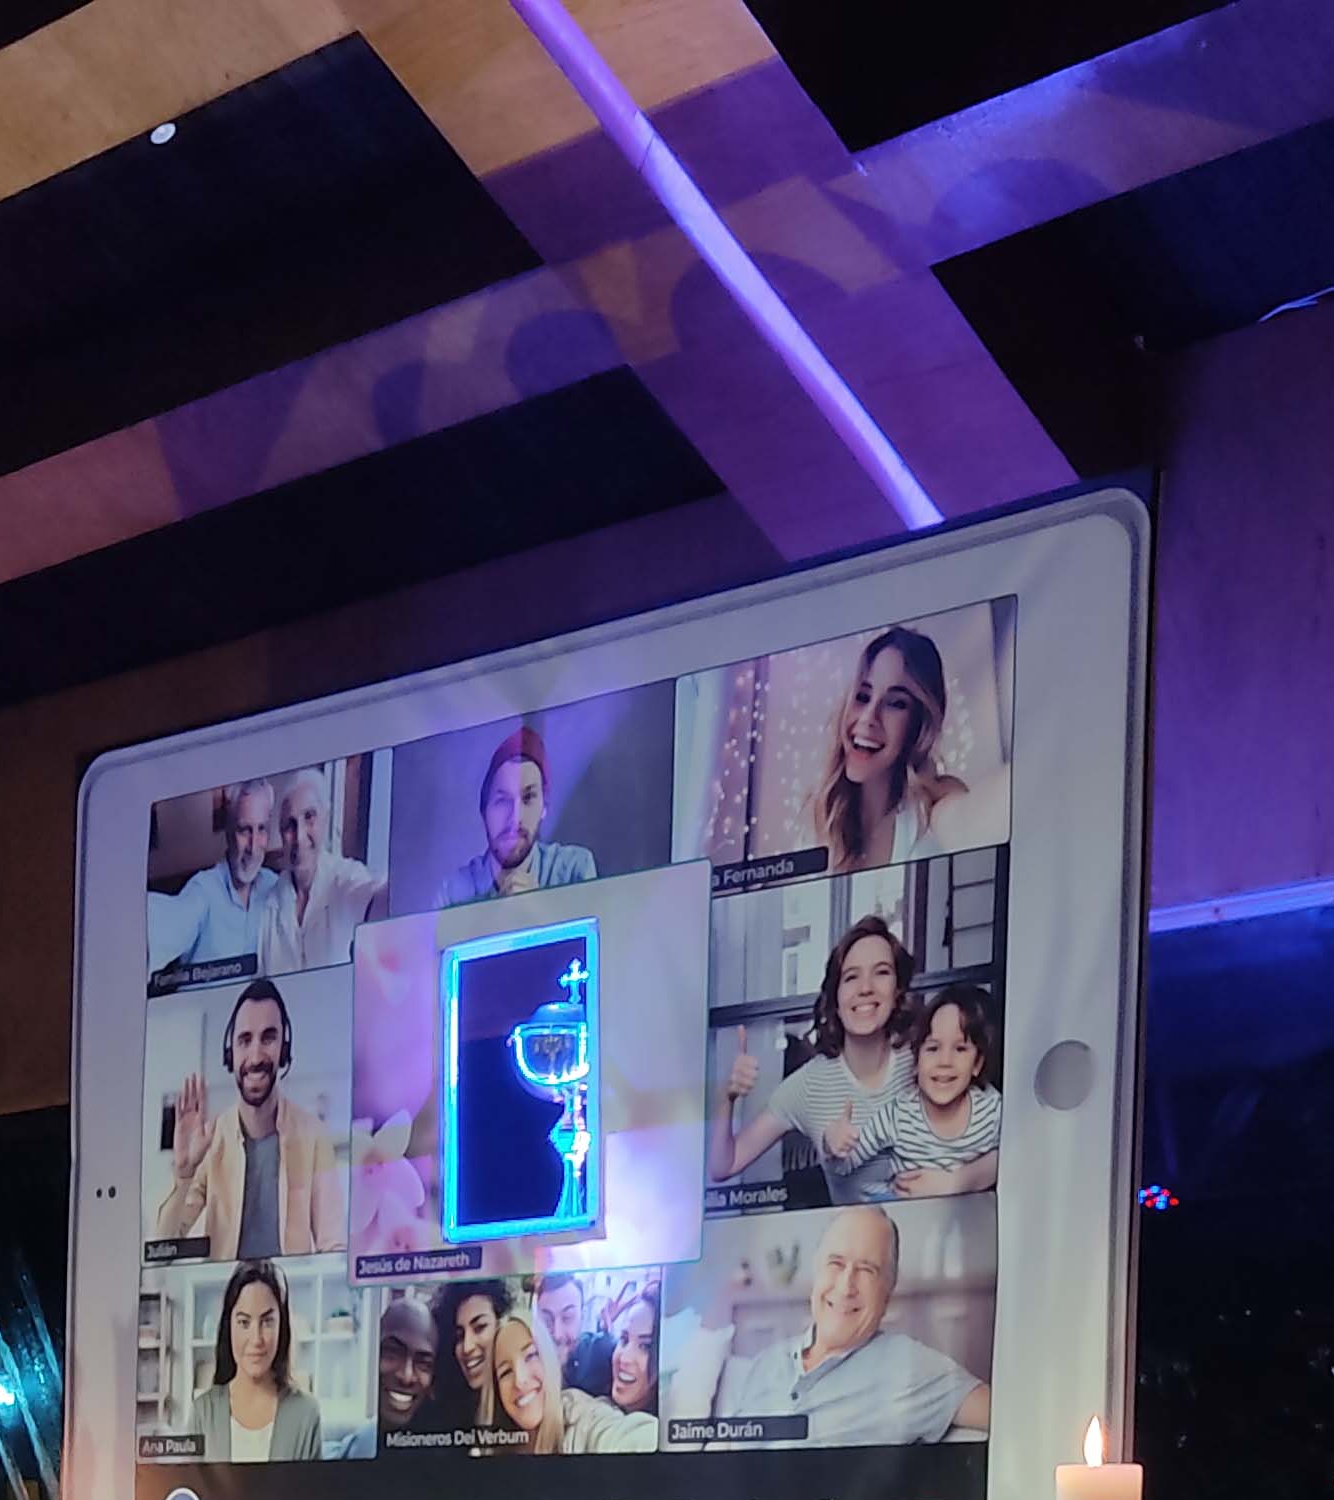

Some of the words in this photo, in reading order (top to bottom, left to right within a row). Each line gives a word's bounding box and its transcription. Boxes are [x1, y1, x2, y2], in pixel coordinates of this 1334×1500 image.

[723, 859, 794, 885] Fernanda
[729, 1185, 788, 1206] Morales
[358, 1256, 393, 1275] Jesús
[394, 1256, 412, 1272] de
[413, 1251, 470, 1271] Nazareth
[386, 1430, 452, 1448] Misioneros
[476, 1428, 530, 1445] Verbum
[671, 1422, 715, 1440] Jaime
[716, 1420, 764, 1438] Durán
[141, 1439, 164, 1456] Ana
[166, 1438, 196, 1454] Paula
